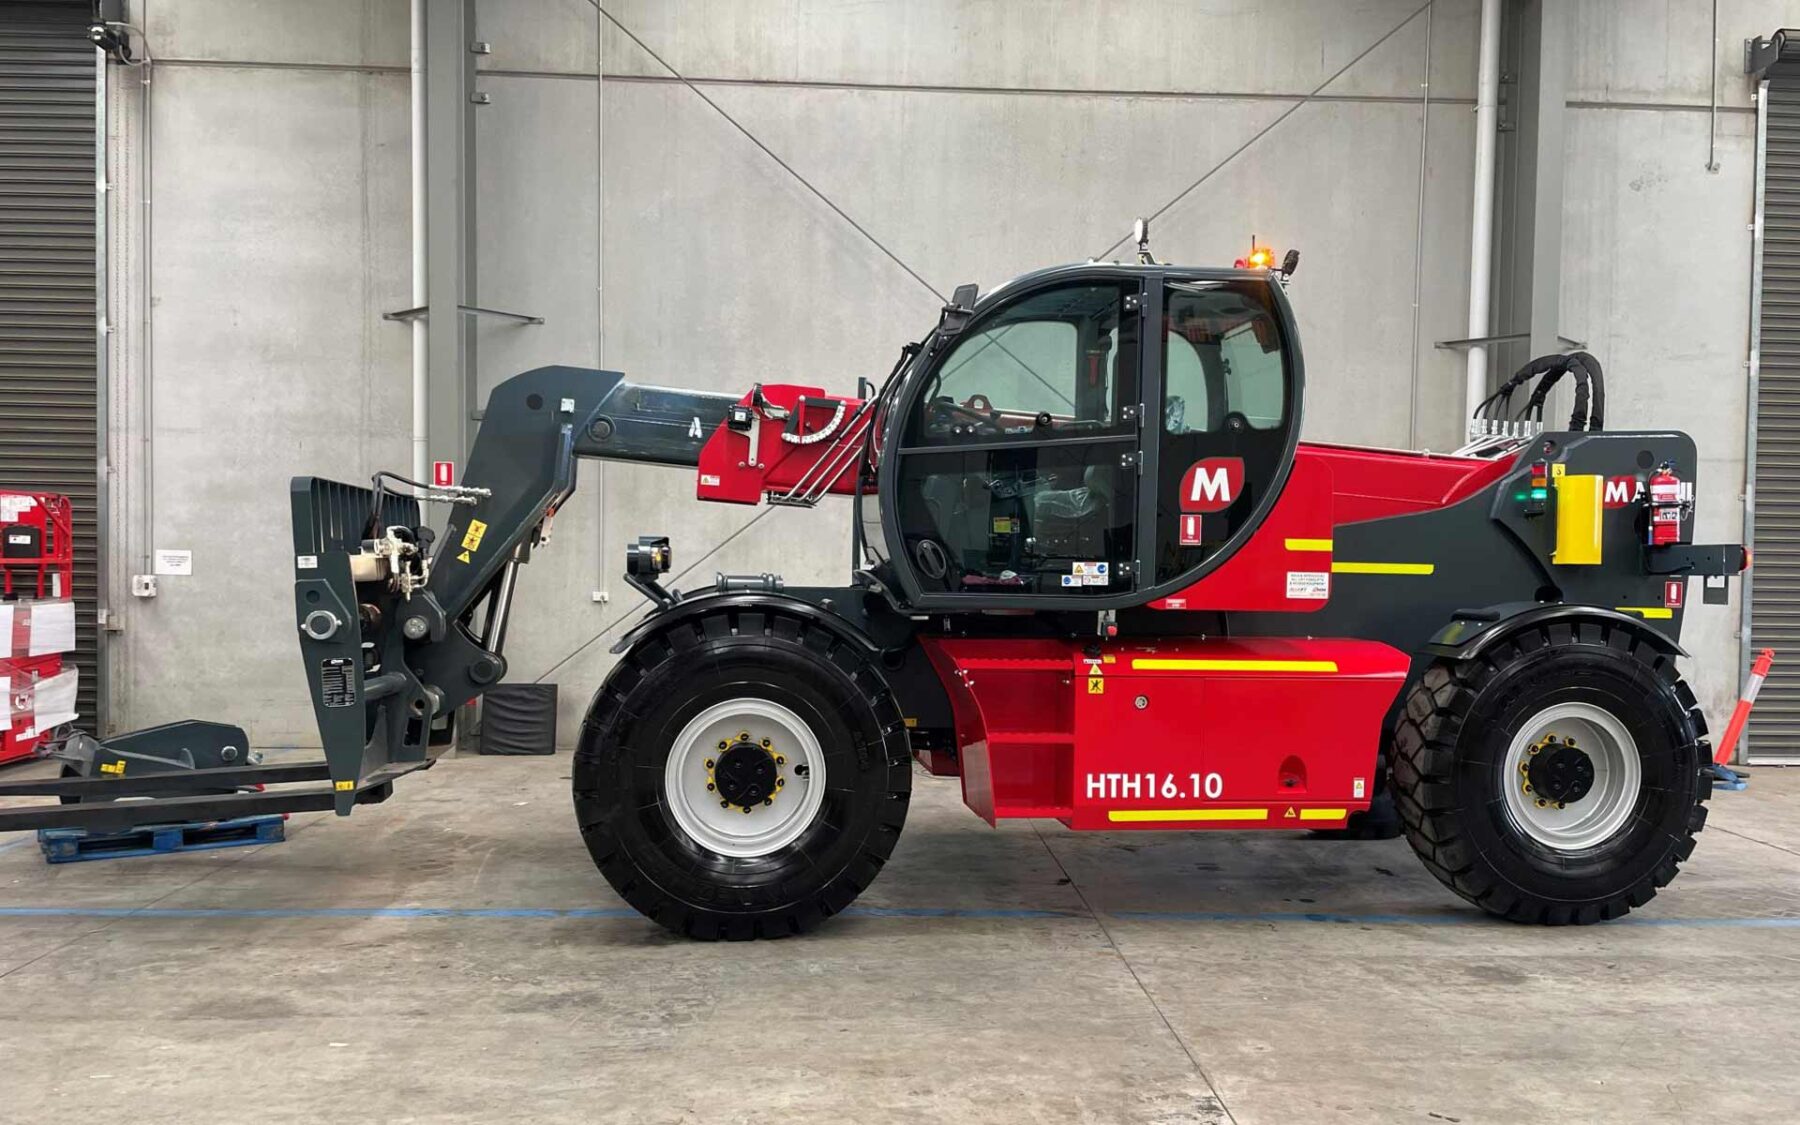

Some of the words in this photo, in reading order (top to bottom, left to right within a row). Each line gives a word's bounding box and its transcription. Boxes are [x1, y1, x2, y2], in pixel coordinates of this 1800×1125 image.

[689, 417, 702, 438] A
[1191, 467, 1230, 502] M
[1086, 772, 1224, 799] HTH16.10
